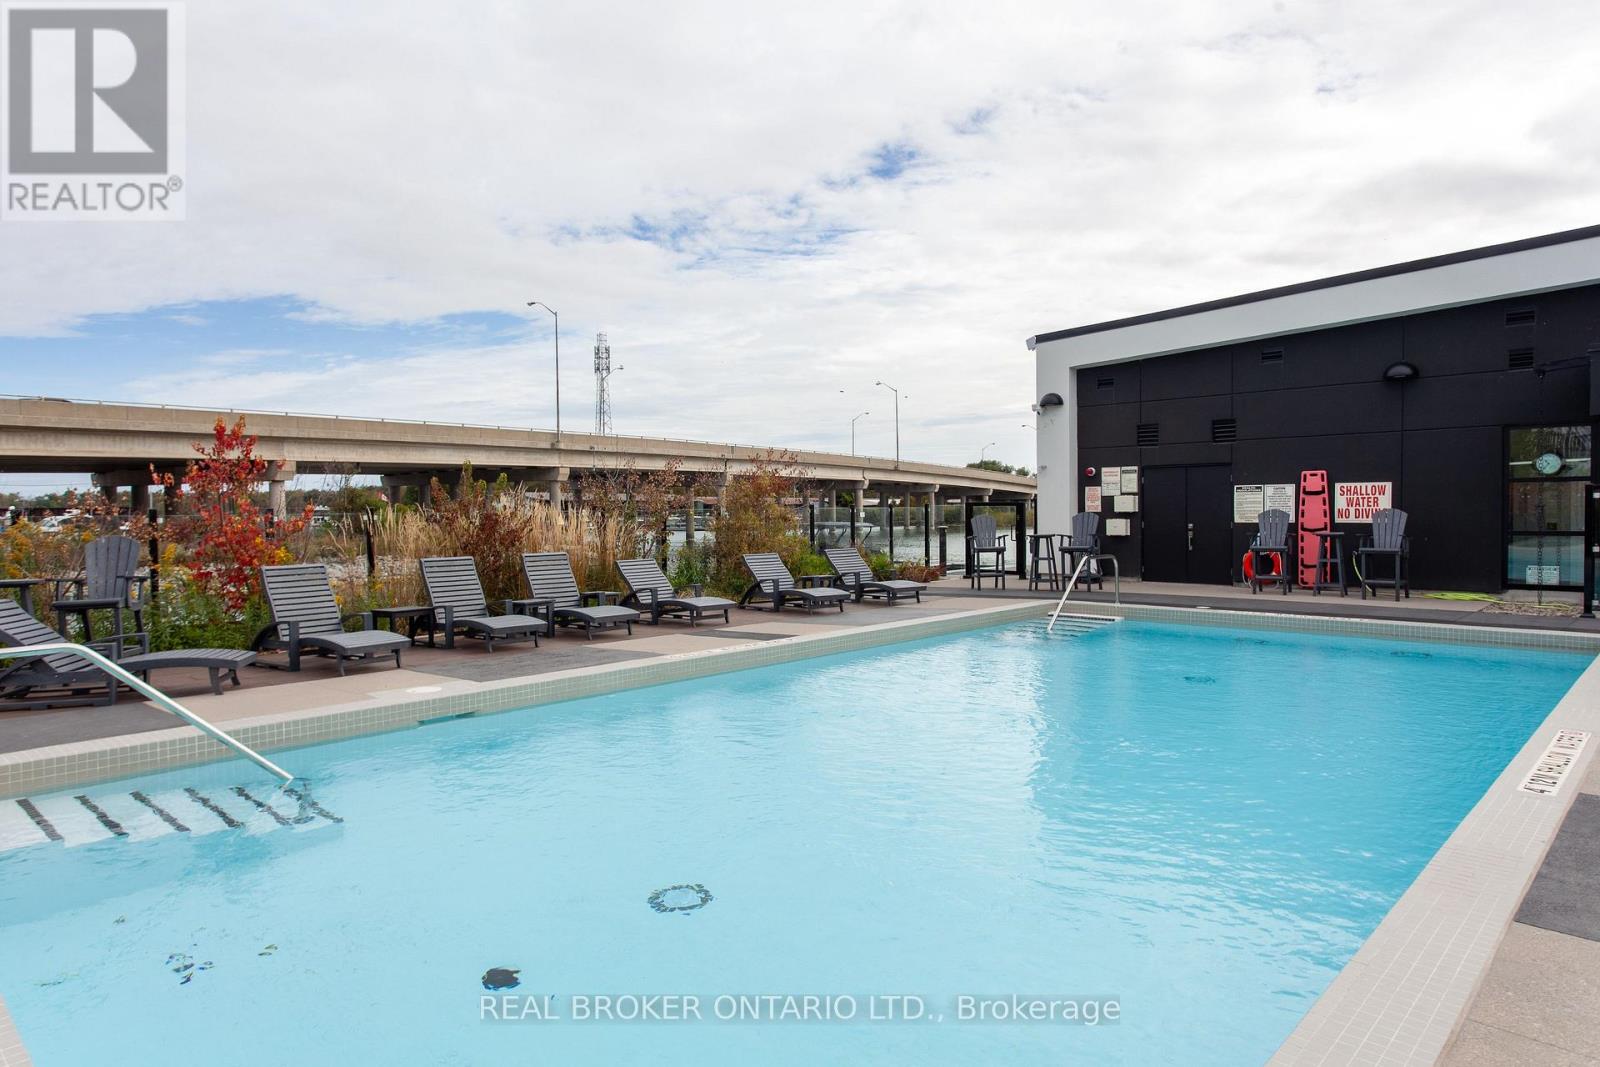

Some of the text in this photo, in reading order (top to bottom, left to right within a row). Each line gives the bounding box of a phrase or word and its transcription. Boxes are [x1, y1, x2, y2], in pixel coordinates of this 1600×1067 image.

[1339, 485, 1387, 497] SHALLOW
[1345, 496, 1379, 508] WATER
[1337, 508, 1351, 519] NO
